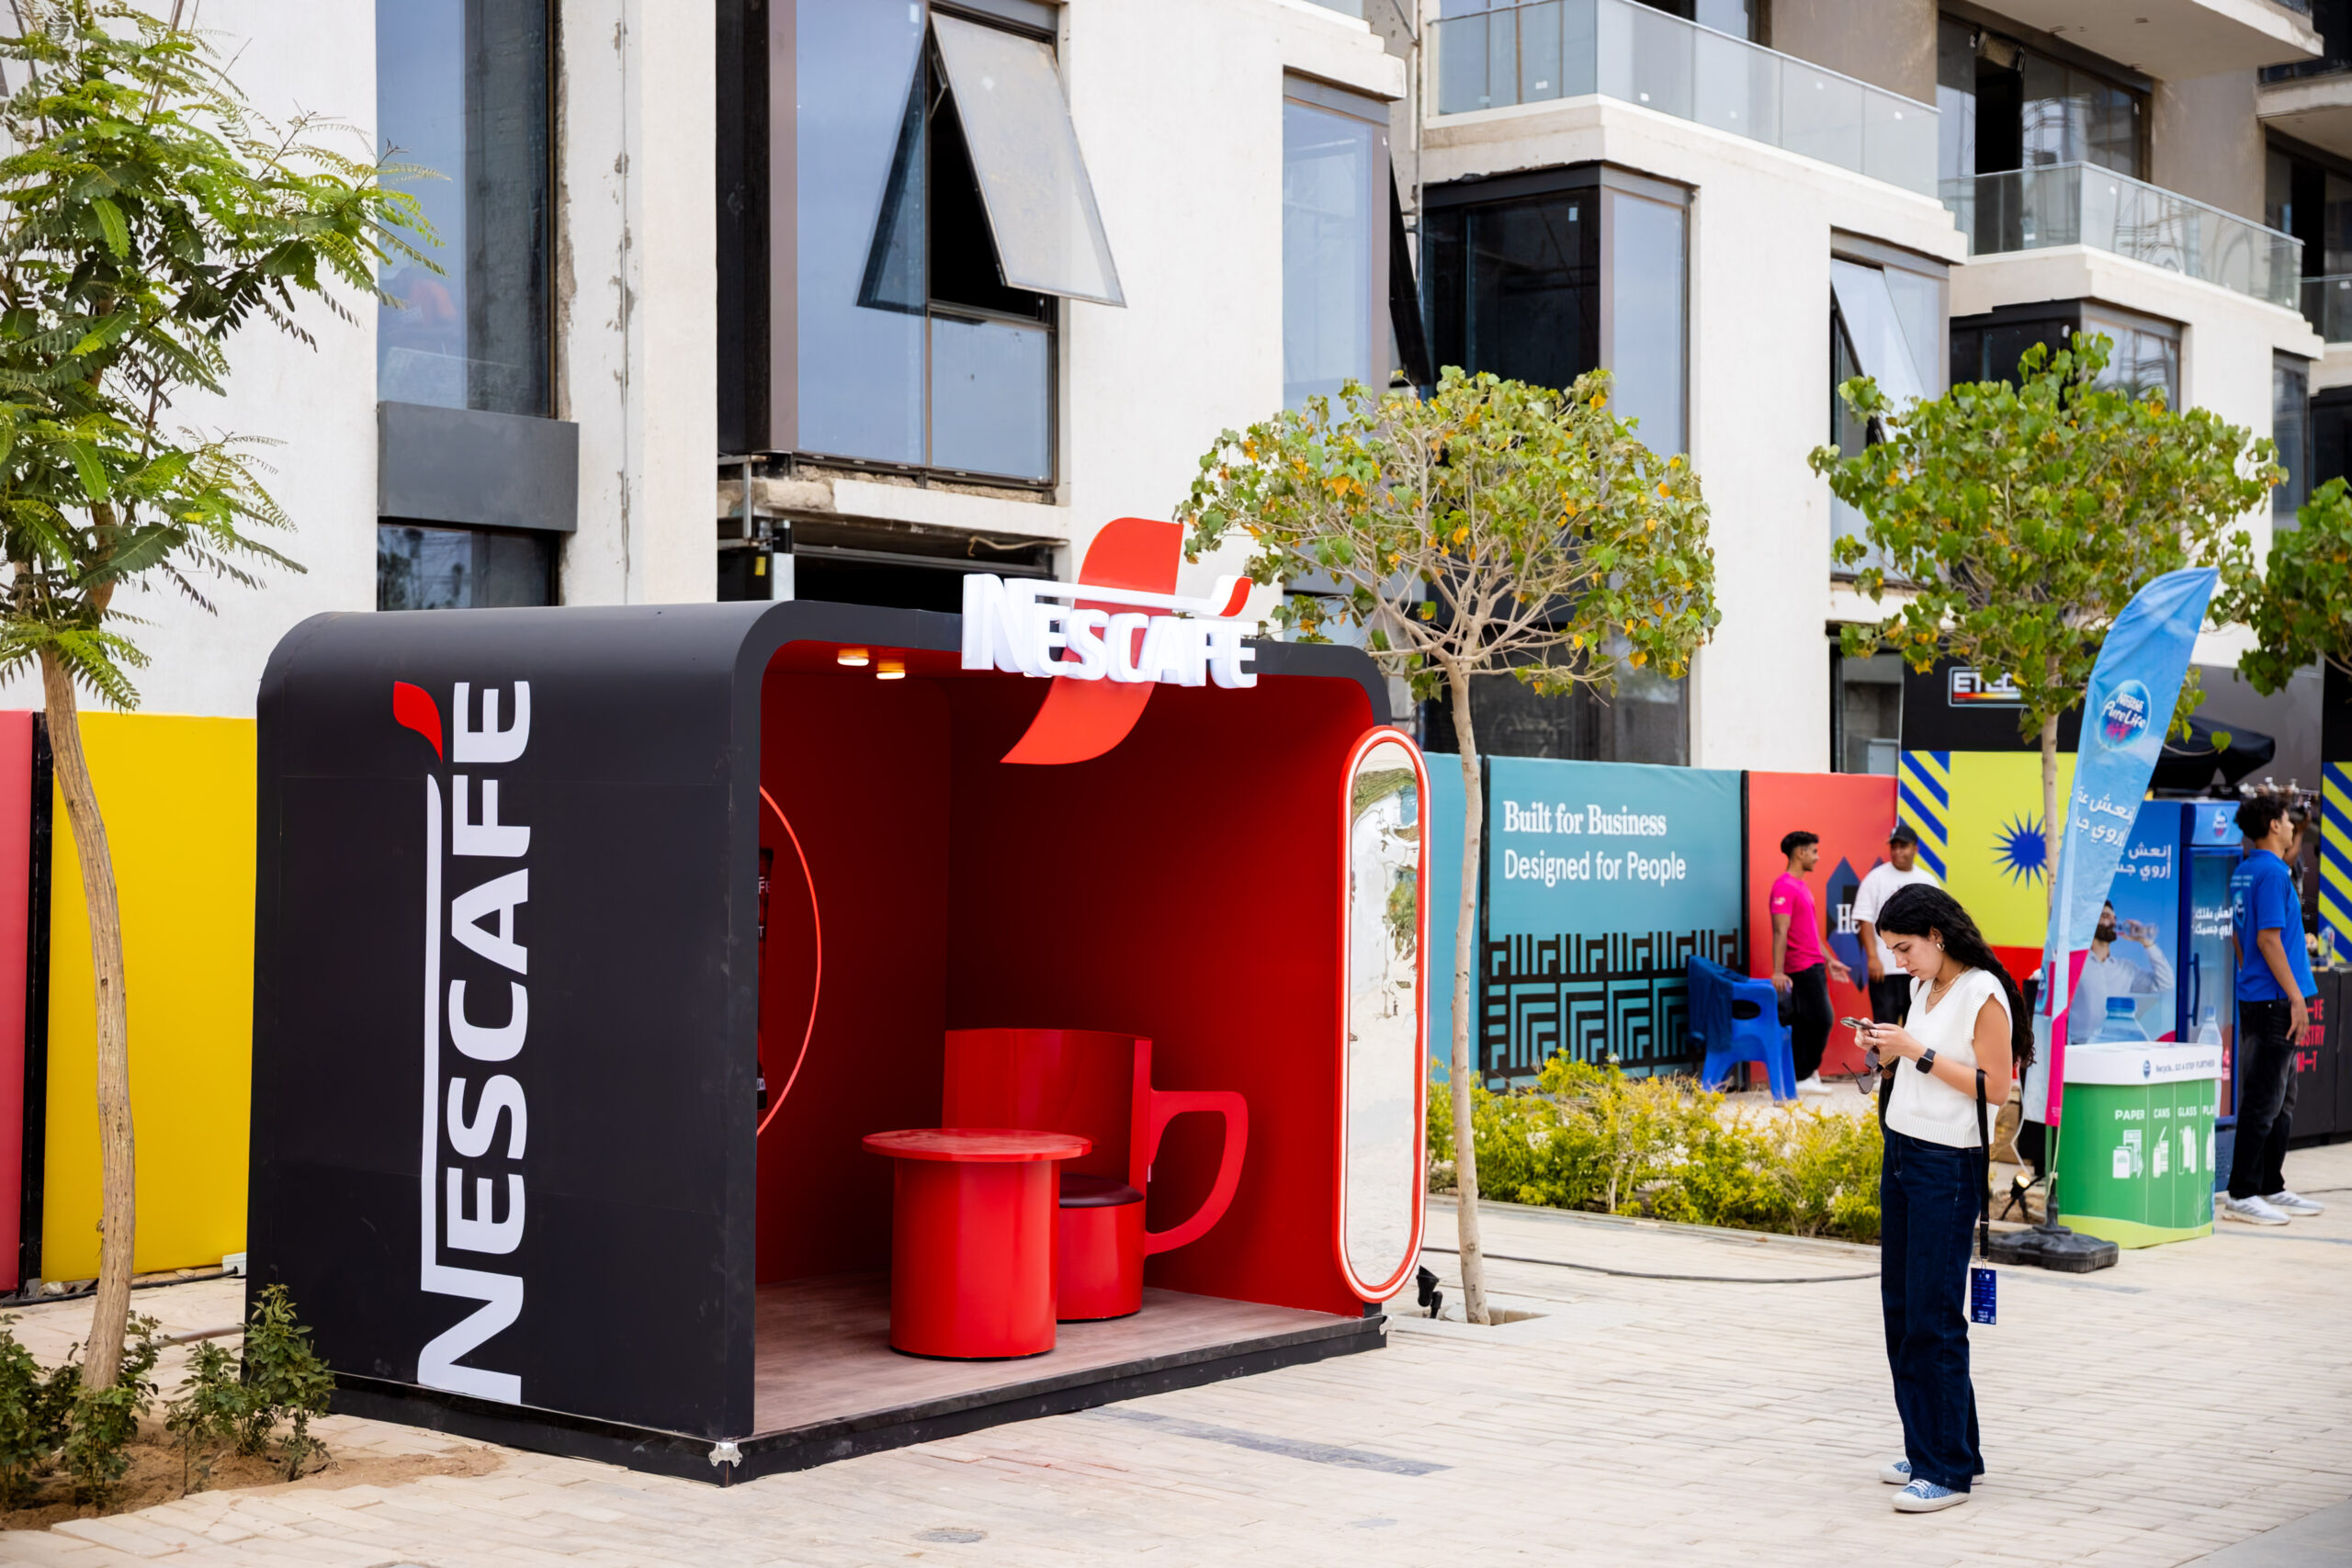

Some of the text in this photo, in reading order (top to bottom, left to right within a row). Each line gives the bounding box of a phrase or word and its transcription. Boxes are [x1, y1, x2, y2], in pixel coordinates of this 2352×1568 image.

[1503, 800, 1668, 836] Built for Business
[1504, 849, 1687, 887] Designed for People
[2115, 1110, 2145, 1120] PAPER
[2154, 1108, 2171, 1119] CANS
[2177, 1106, 2197, 1117] GLASS
[2203, 1105, 2215, 1116] PLA
